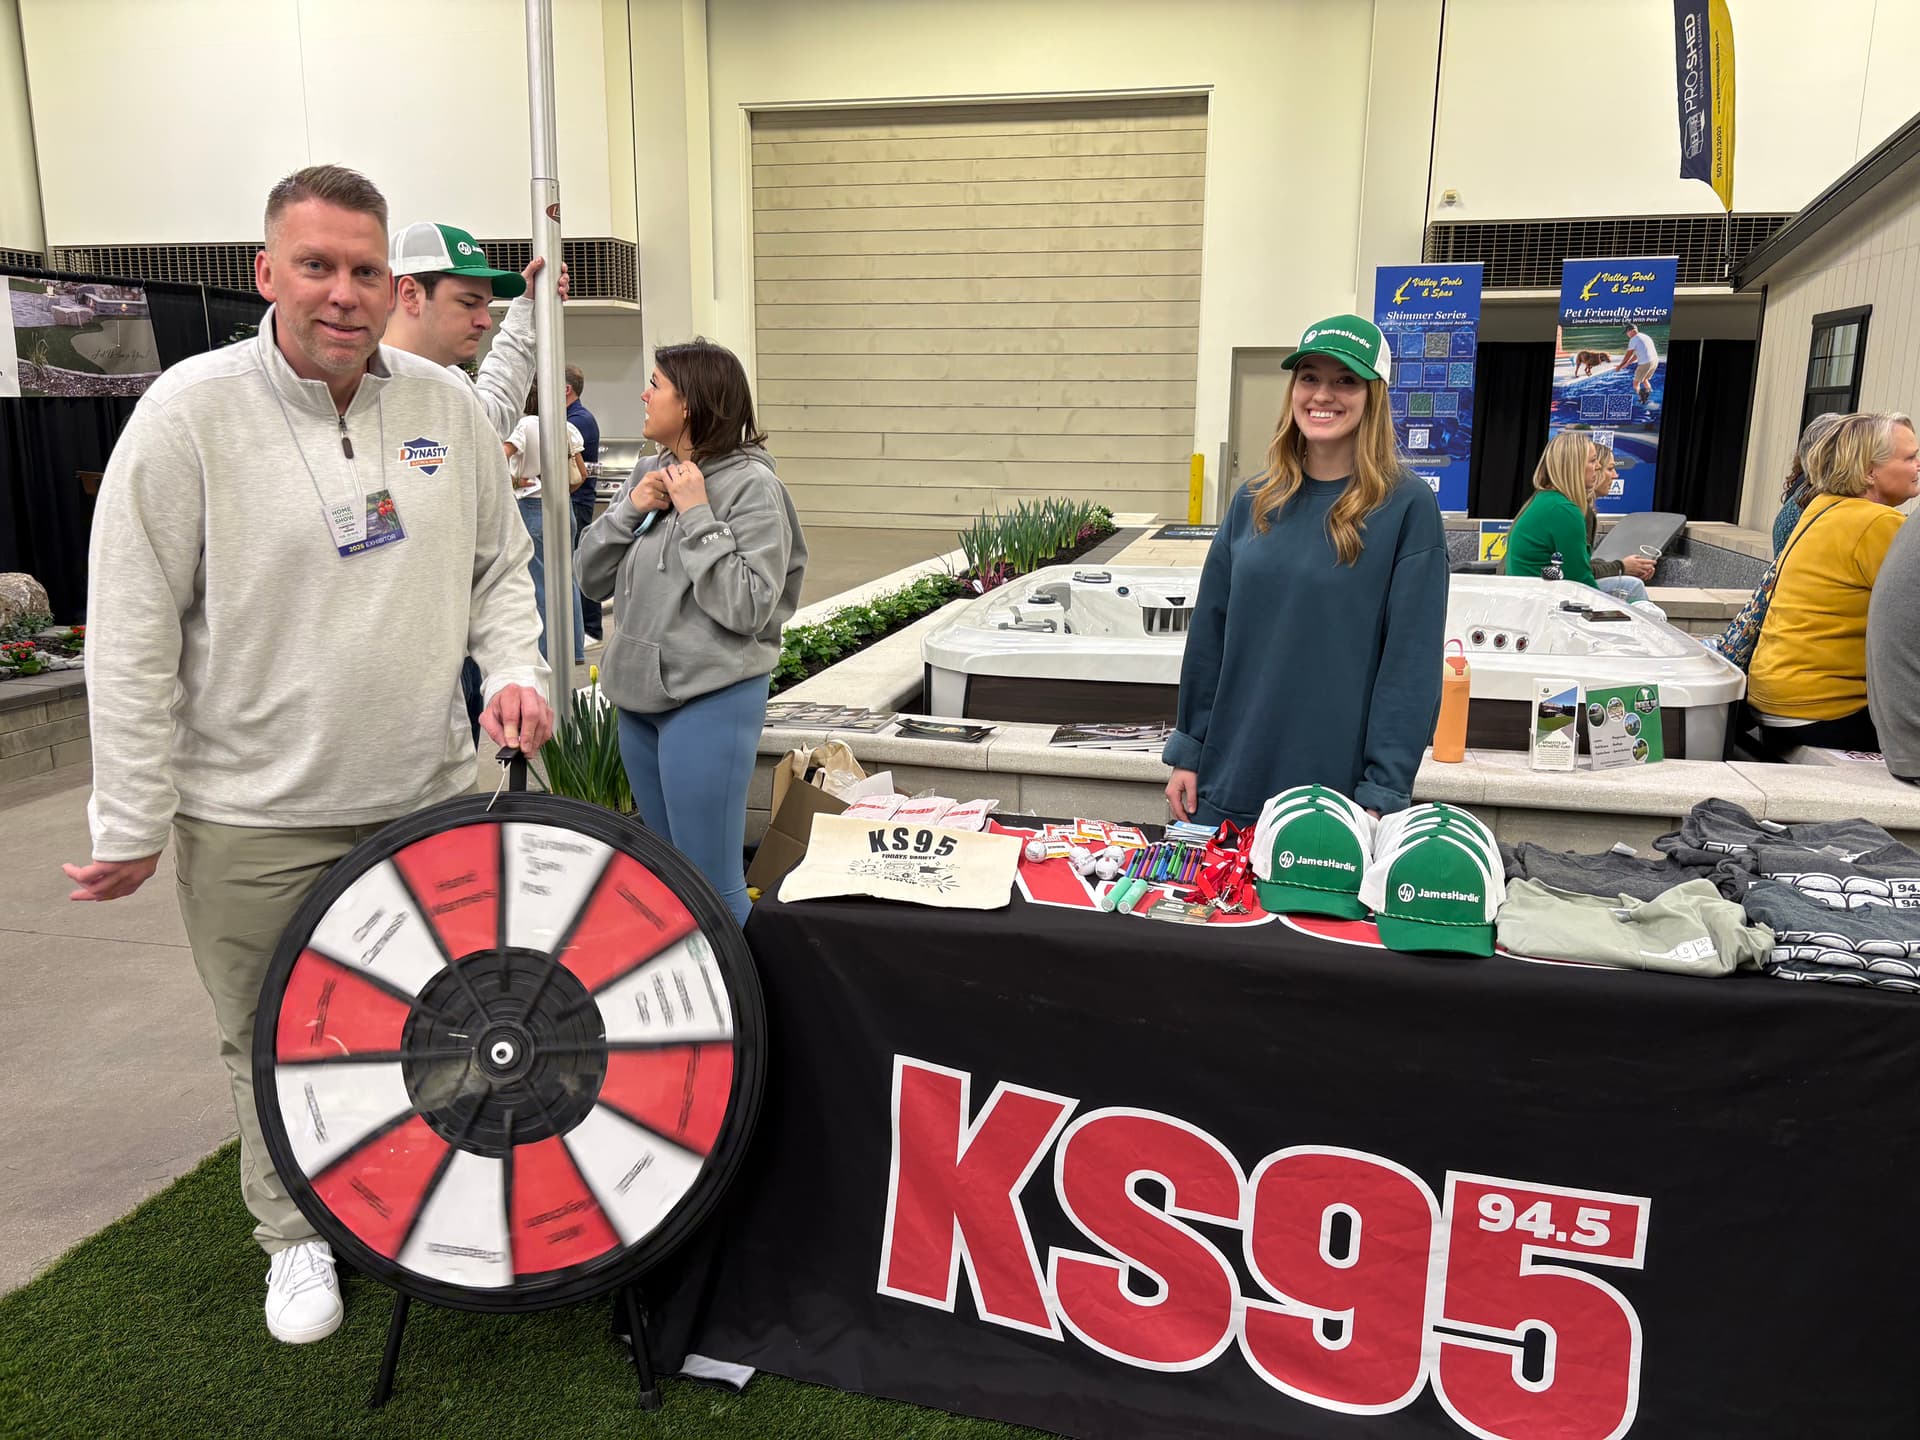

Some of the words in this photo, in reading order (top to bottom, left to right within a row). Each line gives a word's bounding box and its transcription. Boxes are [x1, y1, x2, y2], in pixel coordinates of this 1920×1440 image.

[1412, 278, 1438, 288] Valley
[1440, 277, 1463, 286] Pools
[1601, 272, 1628, 283] Valley
[1631, 272, 1656, 281] Pools
[1421, 288, 1428, 297] &
[1431, 288, 1454, 299] Spas
[1610, 284, 1618, 293] &
[1621, 284, 1645, 294] Spas
[1386, 310, 1434, 320] Shimmer
[1434, 310, 1467, 320] Series
[1564, 308, 1583, 318] Pet
[1584, 307, 1632, 318] Friendly
[1633, 306, 1668, 316] Series
[1318, 329, 1371, 349] JamesHardie
[400, 446, 448, 461] DYNASTY
[332, 506, 352, 516] HOME
[335, 515, 354, 525] SHOW
[365, 533, 396, 548] EXHIBITOR
[868, 827, 958, 857] KS95
[1296, 855, 1356, 872] JamesHardie
[1418, 887, 1480, 903] JamesHardie
[1477, 1192, 1611, 1248] 94.5
[877, 1054, 1651, 1440] KS95
